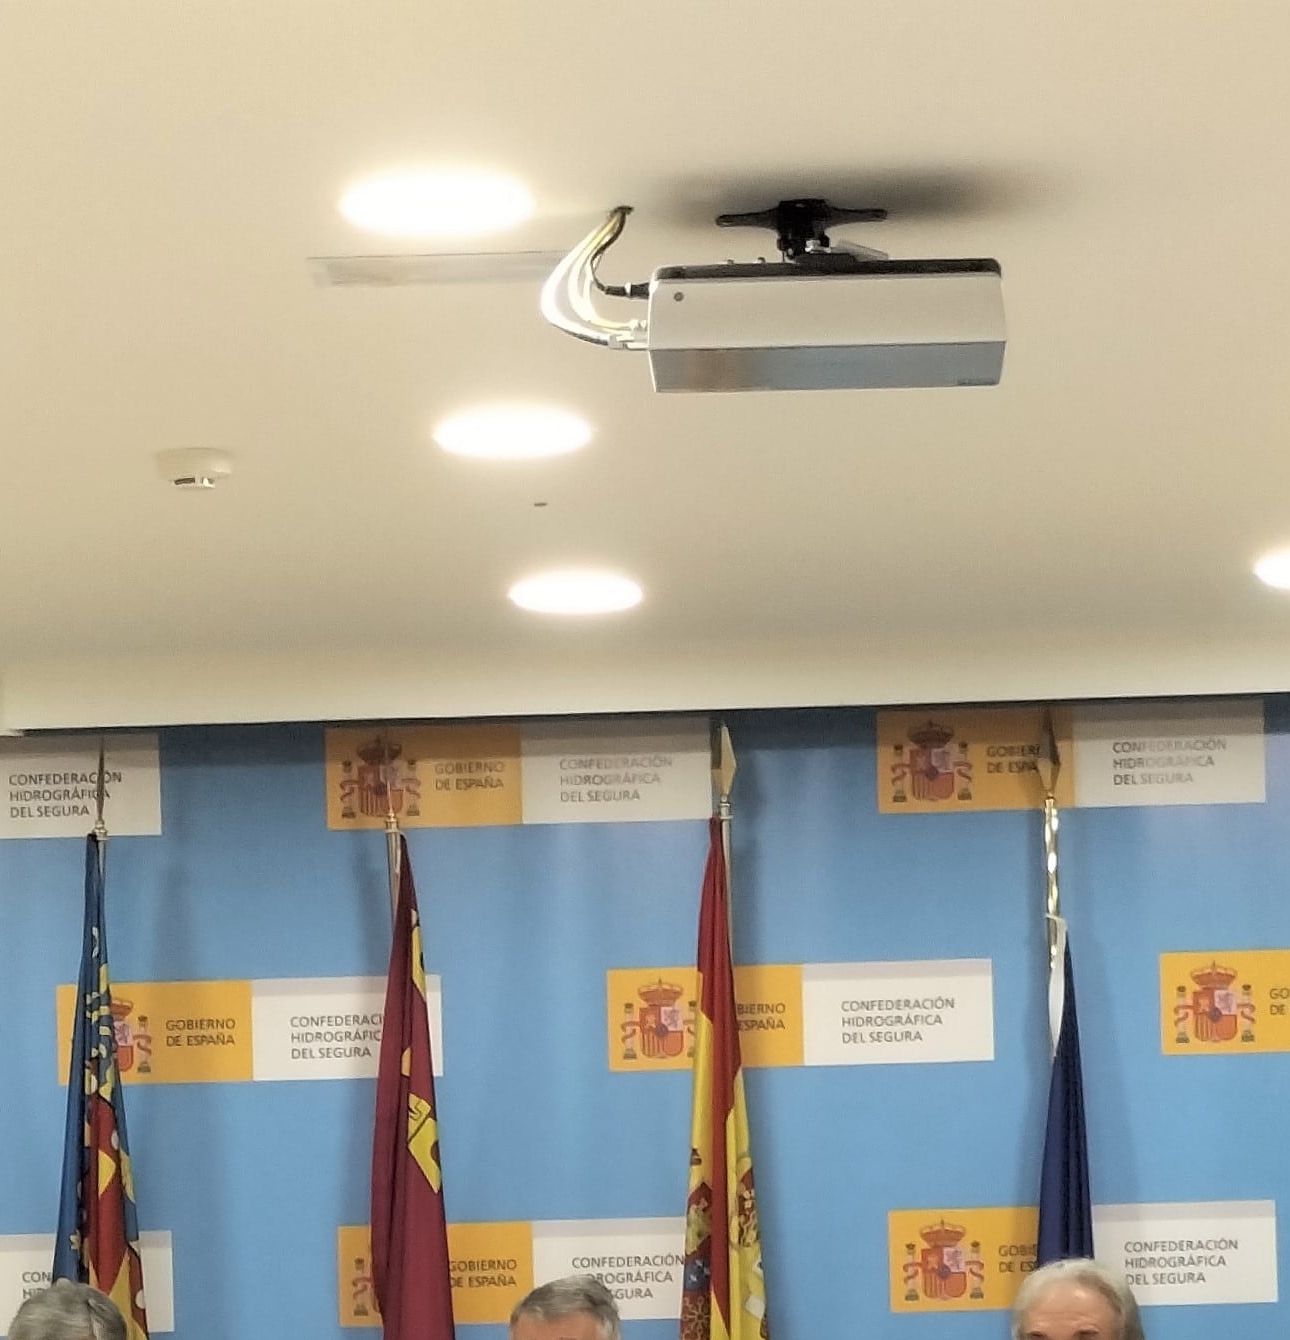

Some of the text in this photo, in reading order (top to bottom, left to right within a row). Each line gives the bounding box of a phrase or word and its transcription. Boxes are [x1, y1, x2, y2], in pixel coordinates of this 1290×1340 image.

[987, 745, 1040, 757] GOBIER
[435, 761, 505, 774] GOBIERNO
[560, 756, 672, 770] CONFEDERACIÓN
[987, 760, 1038, 773] DE ESPA
[9, 771, 122, 786] CONFEDERACÓN
[435, 776, 504, 791] DE ESPAÑA
[560, 773, 661, 786] HIDROGRÁFICA
[1114, 773, 1194, 786] DEL SEGURA
[560, 790, 641, 802] DEL SEGURA
[11, 805, 90, 818] DEL SEGURA
[737, 1002, 786, 1015] BIERNO
[841, 996, 955, 1012] CONFEDERACIÓN
[1270, 1004, 1286, 1016] DE
[166, 1018, 235, 1031] GOBIERNO
[290, 1013, 383, 1029] CONFEDERACI
[842, 1013, 943, 1028] HIDROGRÁFICA
[166, 1031, 235, 1047] DE ESPAÑA
[291, 1029, 381, 1044] HIDROGRÁFIC
[843, 1031, 922, 1044] DEL SEGURA
[292, 1046, 372, 1060] DEL SEGURA
[999, 1244, 1037, 1257] GOBIE
[1124, 1238, 1238, 1254] CONFEDERACIÓN
[572, 1253, 685, 1269] CONFEDERACIÓN
[999, 1261, 1015, 1273] DE
[1125, 1254, 1226, 1269] HIDROGRÁFICA
[469, 1273, 516, 1288] ESPAÑA
[1126, 1272, 1206, 1286] DEL SEGURA
[614, 1286, 653, 1300] GURA
